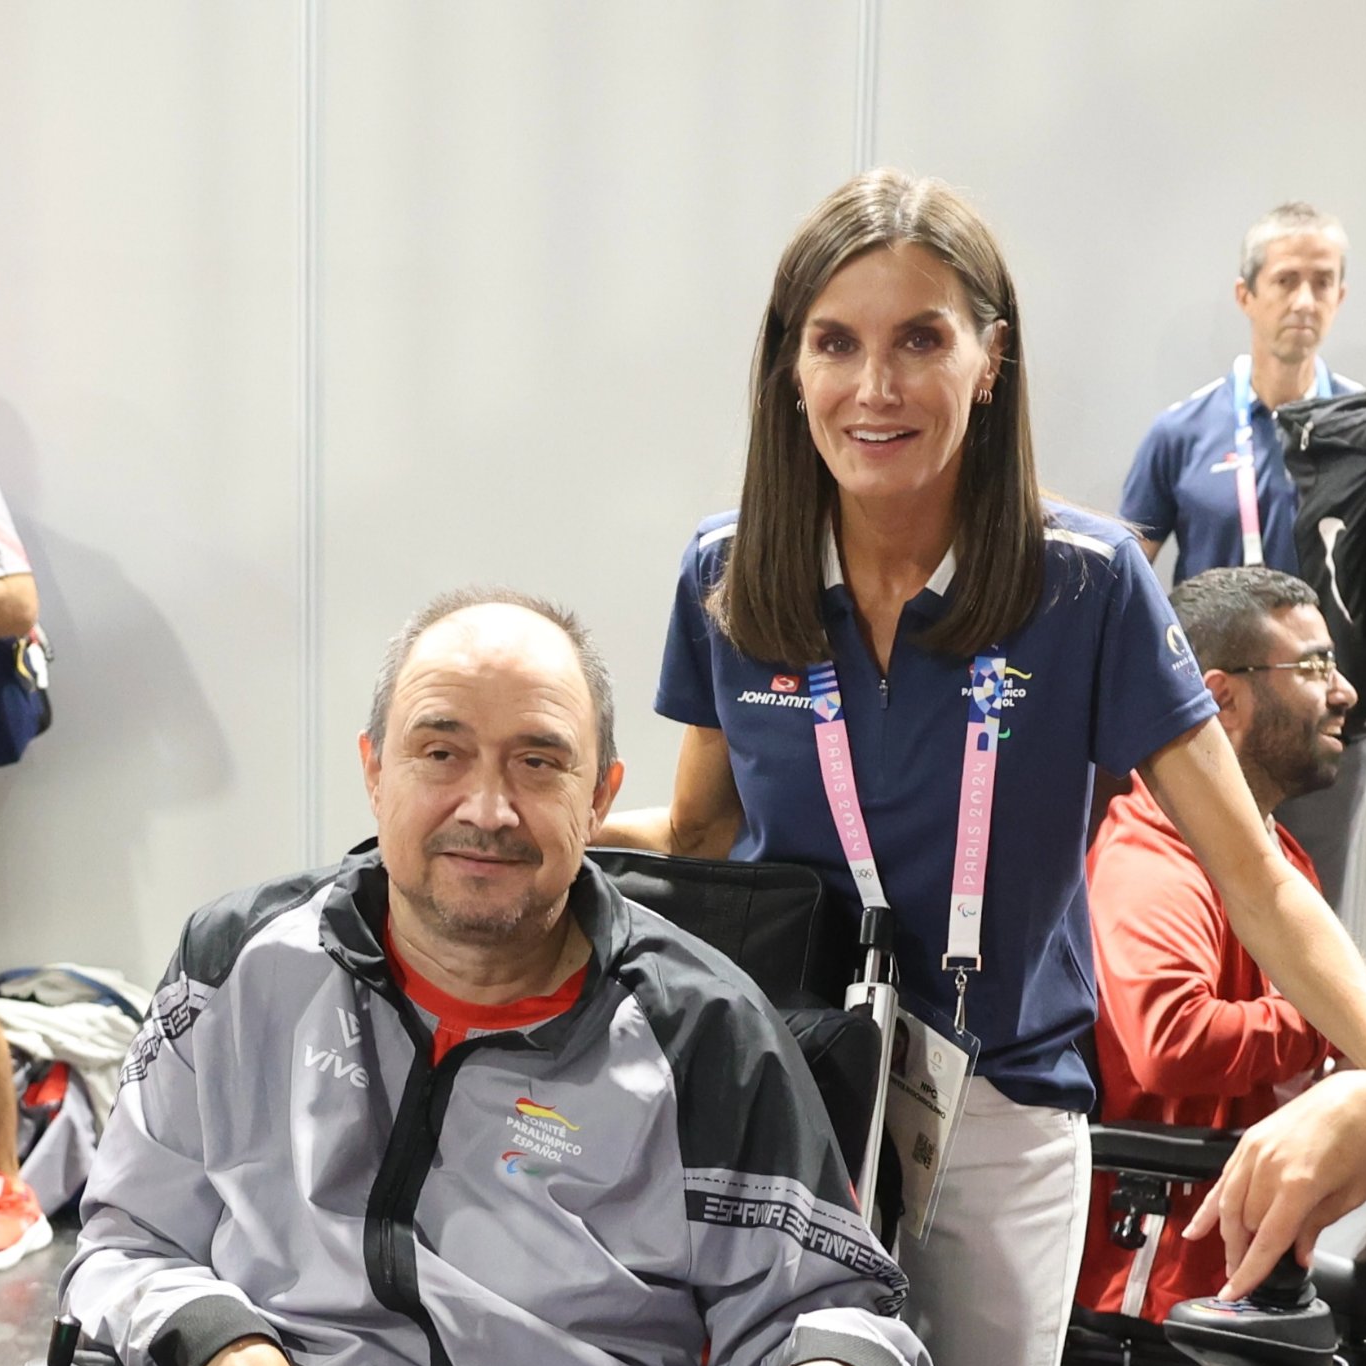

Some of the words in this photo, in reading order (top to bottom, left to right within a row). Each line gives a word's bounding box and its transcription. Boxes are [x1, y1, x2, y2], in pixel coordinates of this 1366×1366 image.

[825, 733, 847, 792] PARIS
[838, 800, 861, 852] 2024
[970, 762, 987, 817] 2024
[963, 825, 982, 886] PARIS
[304, 1044, 369, 1088] vive
[506, 1115, 582, 1156] PARALÍMPICO
[511, 1133, 563, 1163] ESPAÑOL
[522, 1114, 566, 1138] COMITÉ
